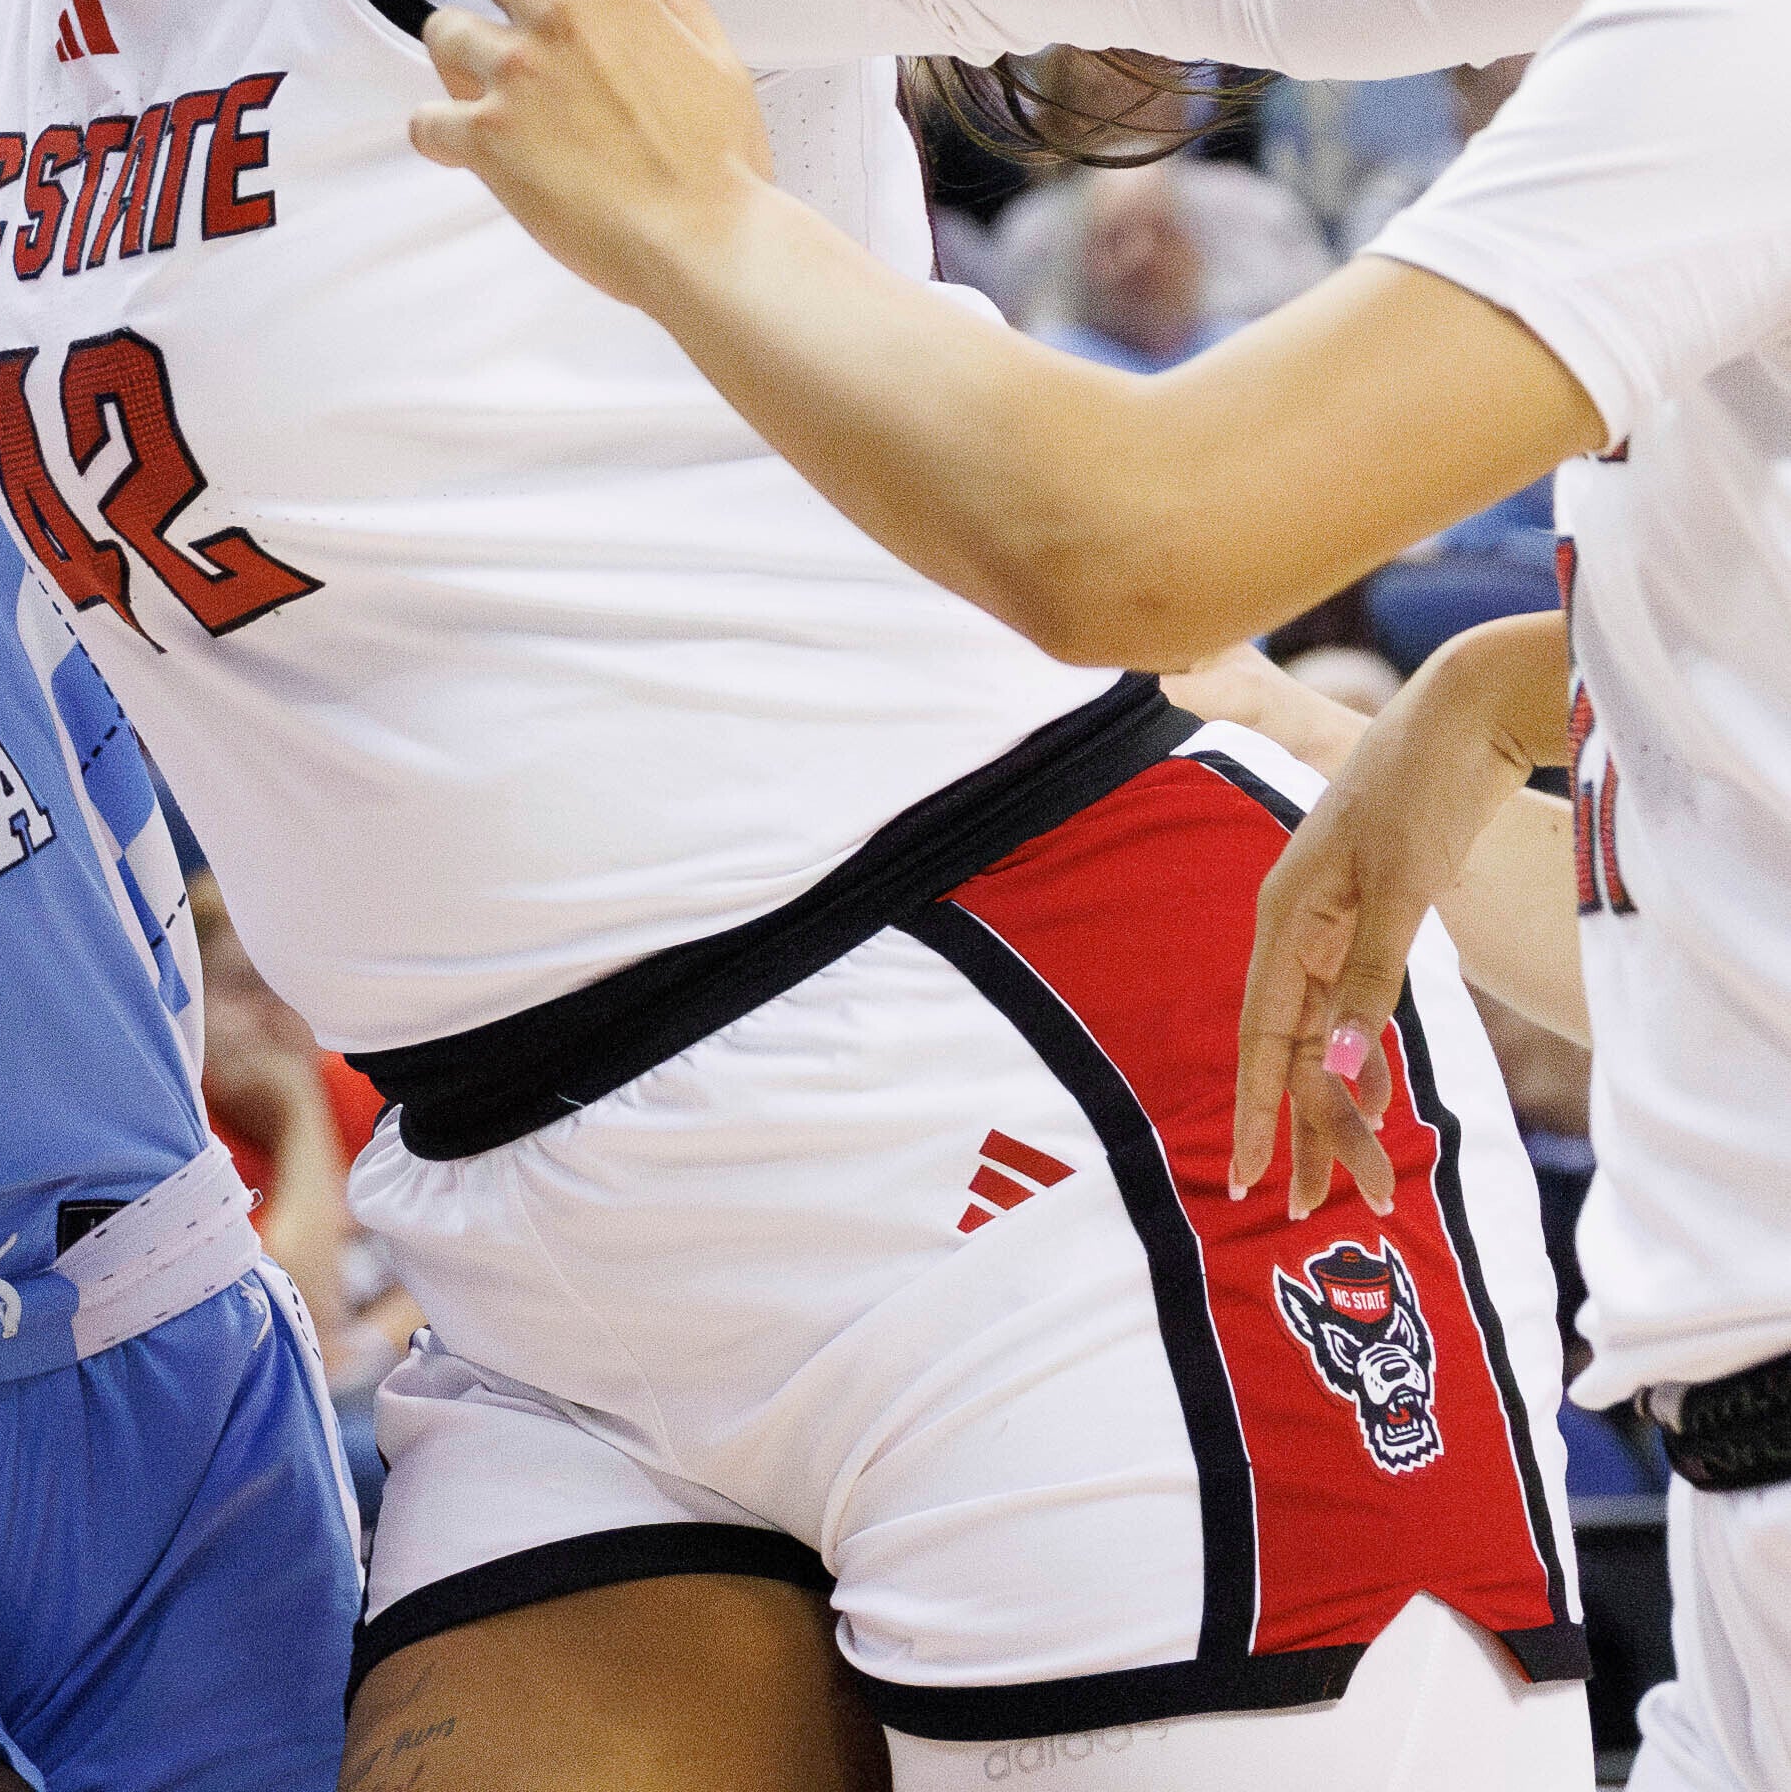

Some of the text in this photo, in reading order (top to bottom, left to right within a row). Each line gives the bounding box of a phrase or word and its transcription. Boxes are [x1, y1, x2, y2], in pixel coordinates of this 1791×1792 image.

[14, 71, 288, 281] STATE
[1331, 1287, 1388, 1311] NC STATE
